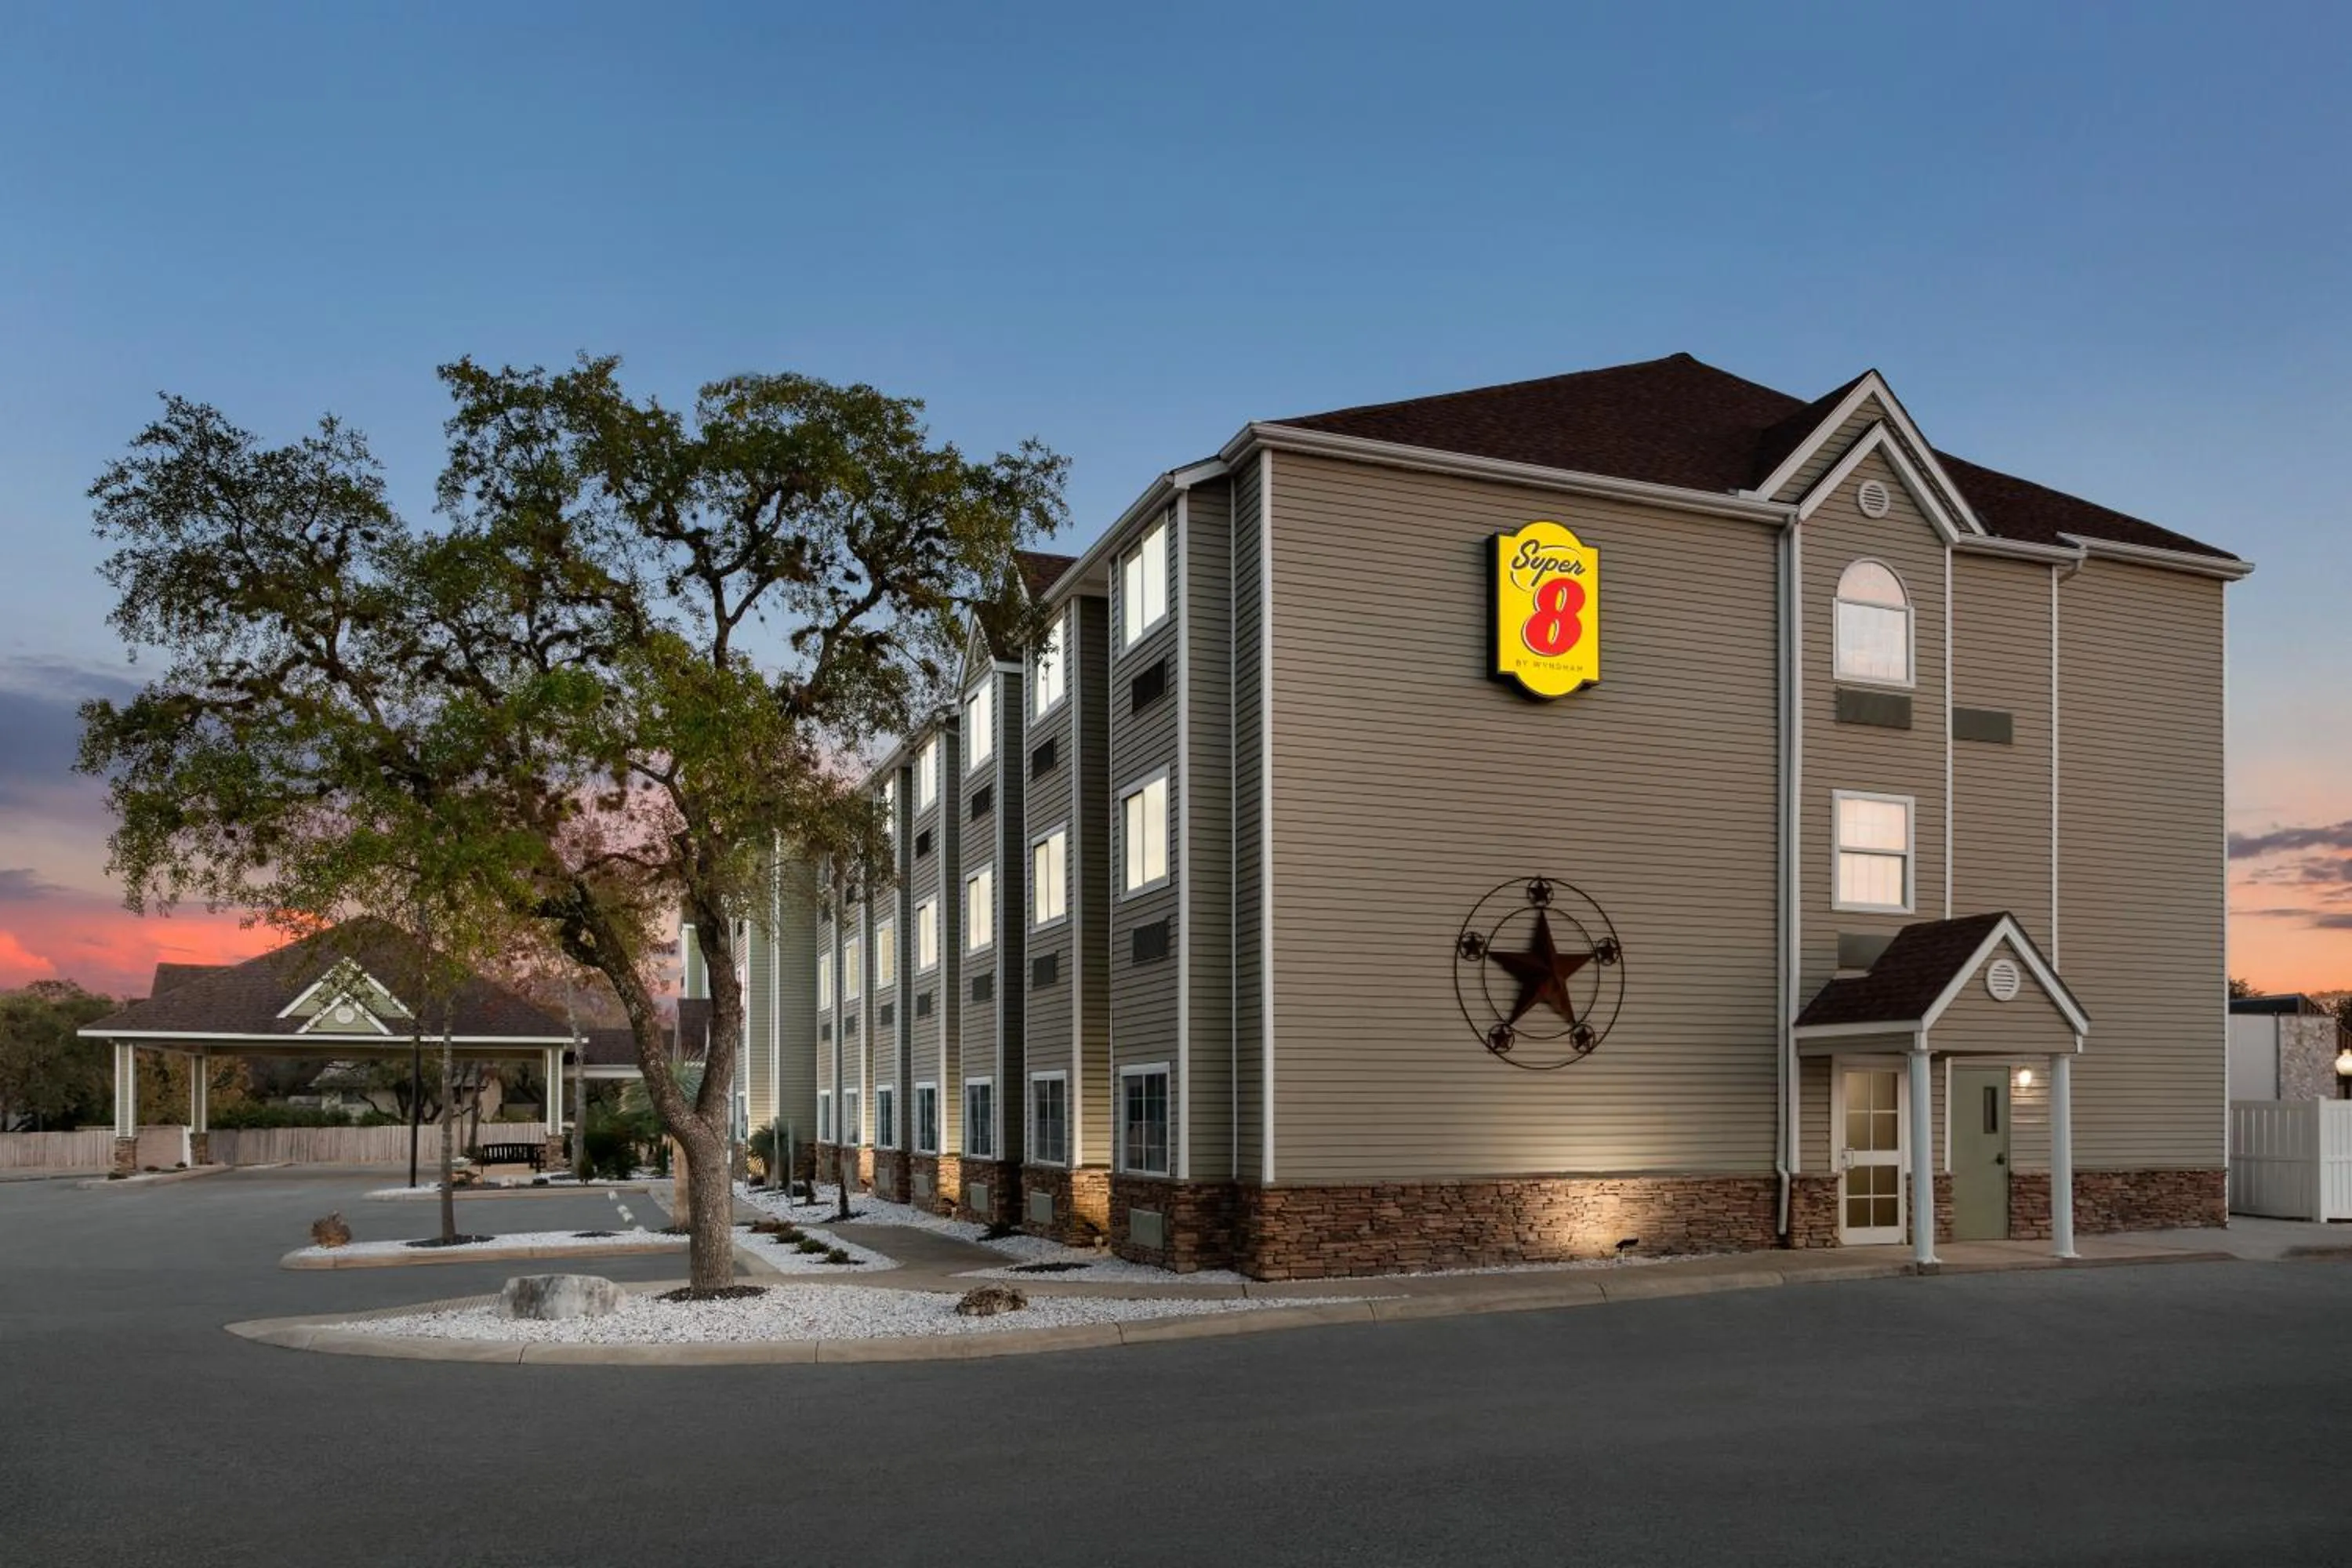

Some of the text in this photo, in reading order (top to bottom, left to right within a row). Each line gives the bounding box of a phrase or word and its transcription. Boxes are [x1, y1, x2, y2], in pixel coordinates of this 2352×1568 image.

[1511, 539, 1585, 586] Super
[1521, 577, 1586, 657] 8
[1515, 659, 1583, 672] BY WYNDHAM
